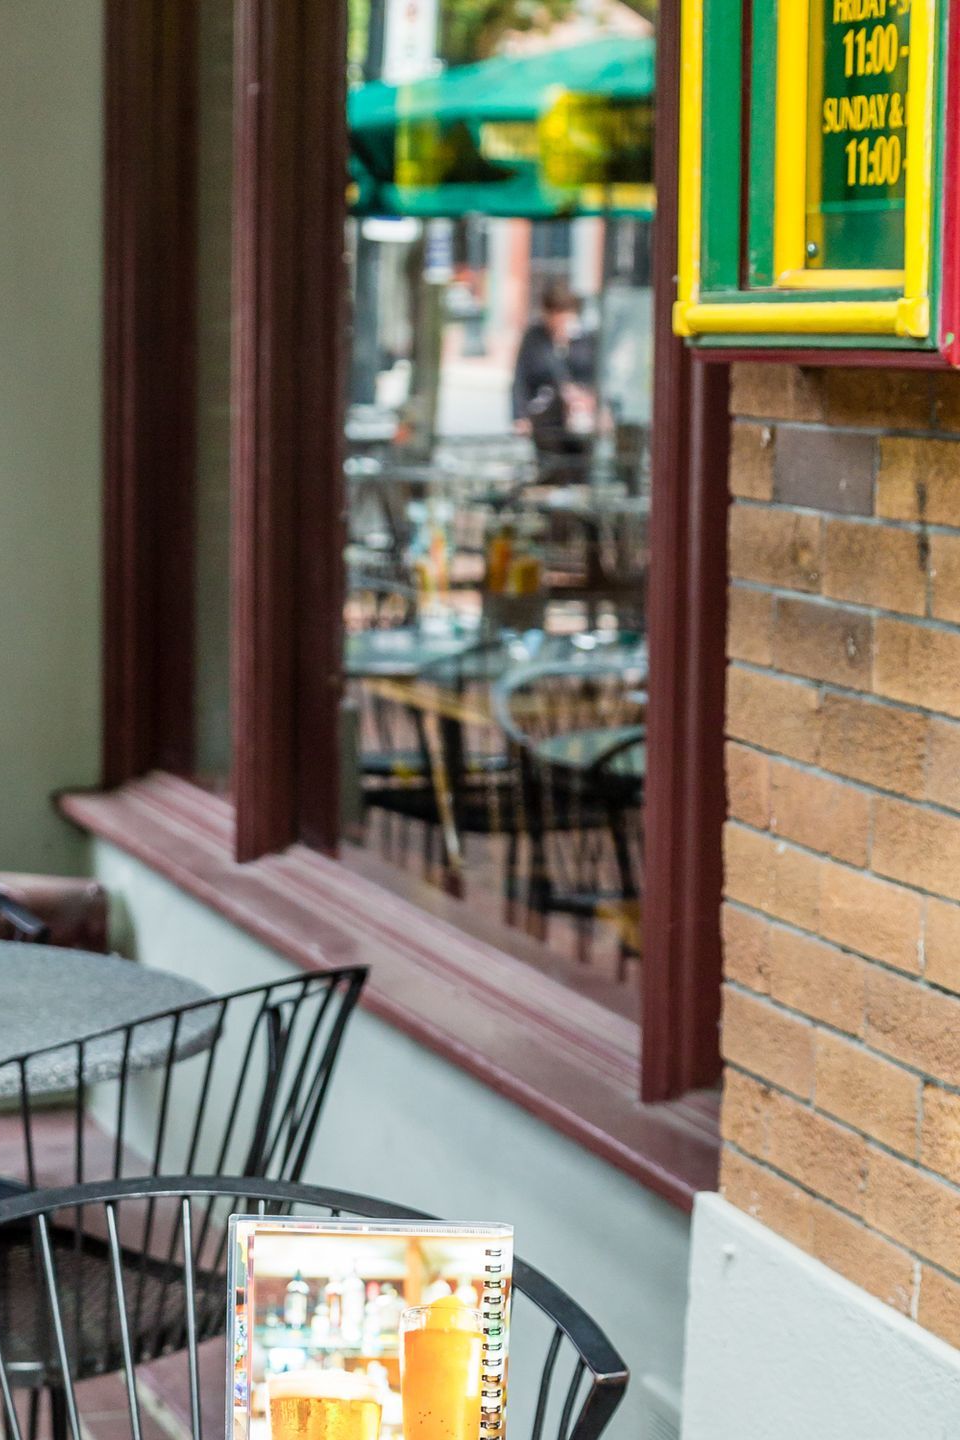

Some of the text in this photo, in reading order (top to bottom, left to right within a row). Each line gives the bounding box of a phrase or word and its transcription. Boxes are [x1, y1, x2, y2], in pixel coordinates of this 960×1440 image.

[843, 24, 898, 78] 11:00
[822, 92, 904, 134] SUNDAY &
[845, 135, 900, 187] 11:00
